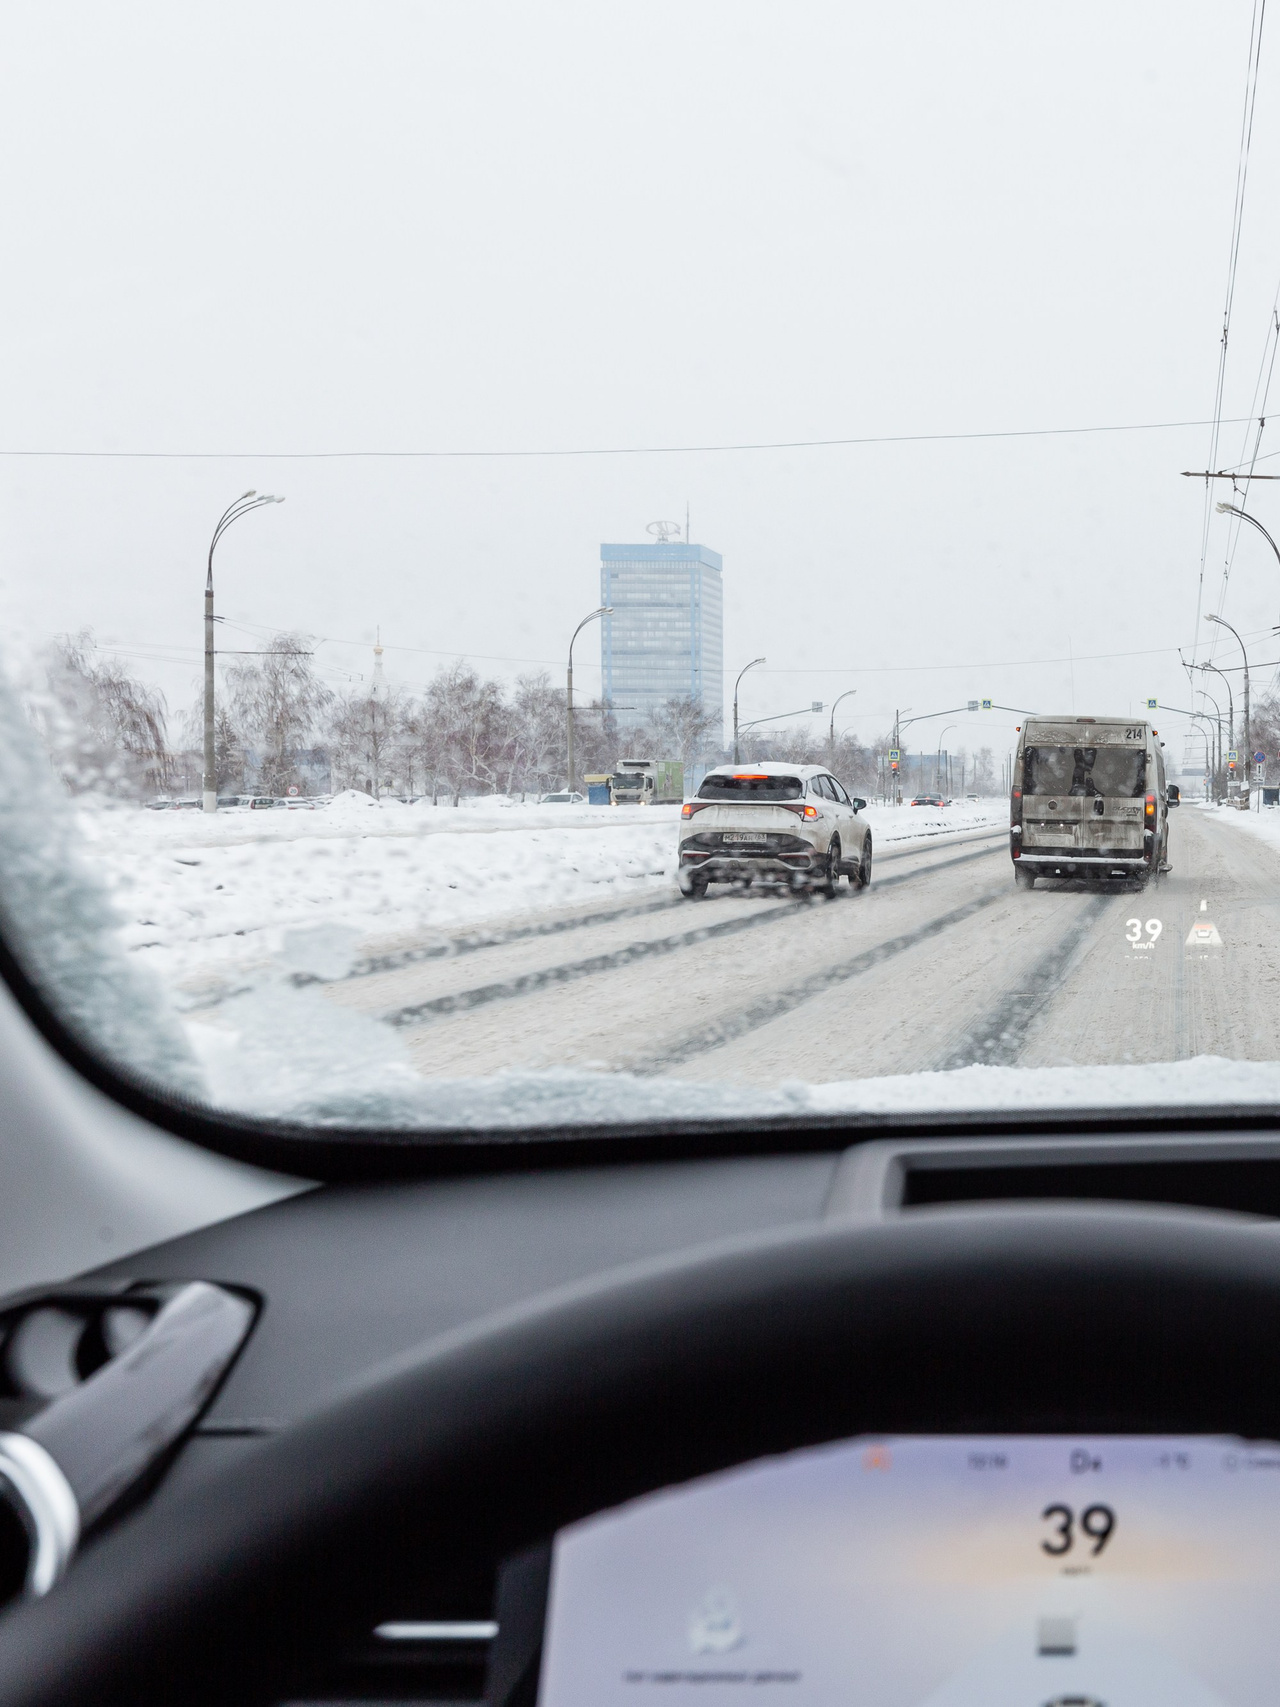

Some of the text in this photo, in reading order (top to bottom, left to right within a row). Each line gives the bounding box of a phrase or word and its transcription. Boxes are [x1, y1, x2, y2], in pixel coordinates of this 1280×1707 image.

[1125, 729, 1142, 739] 214
[1125, 918, 1163, 942] 39
[1041, 1502, 1116, 1557] 39
